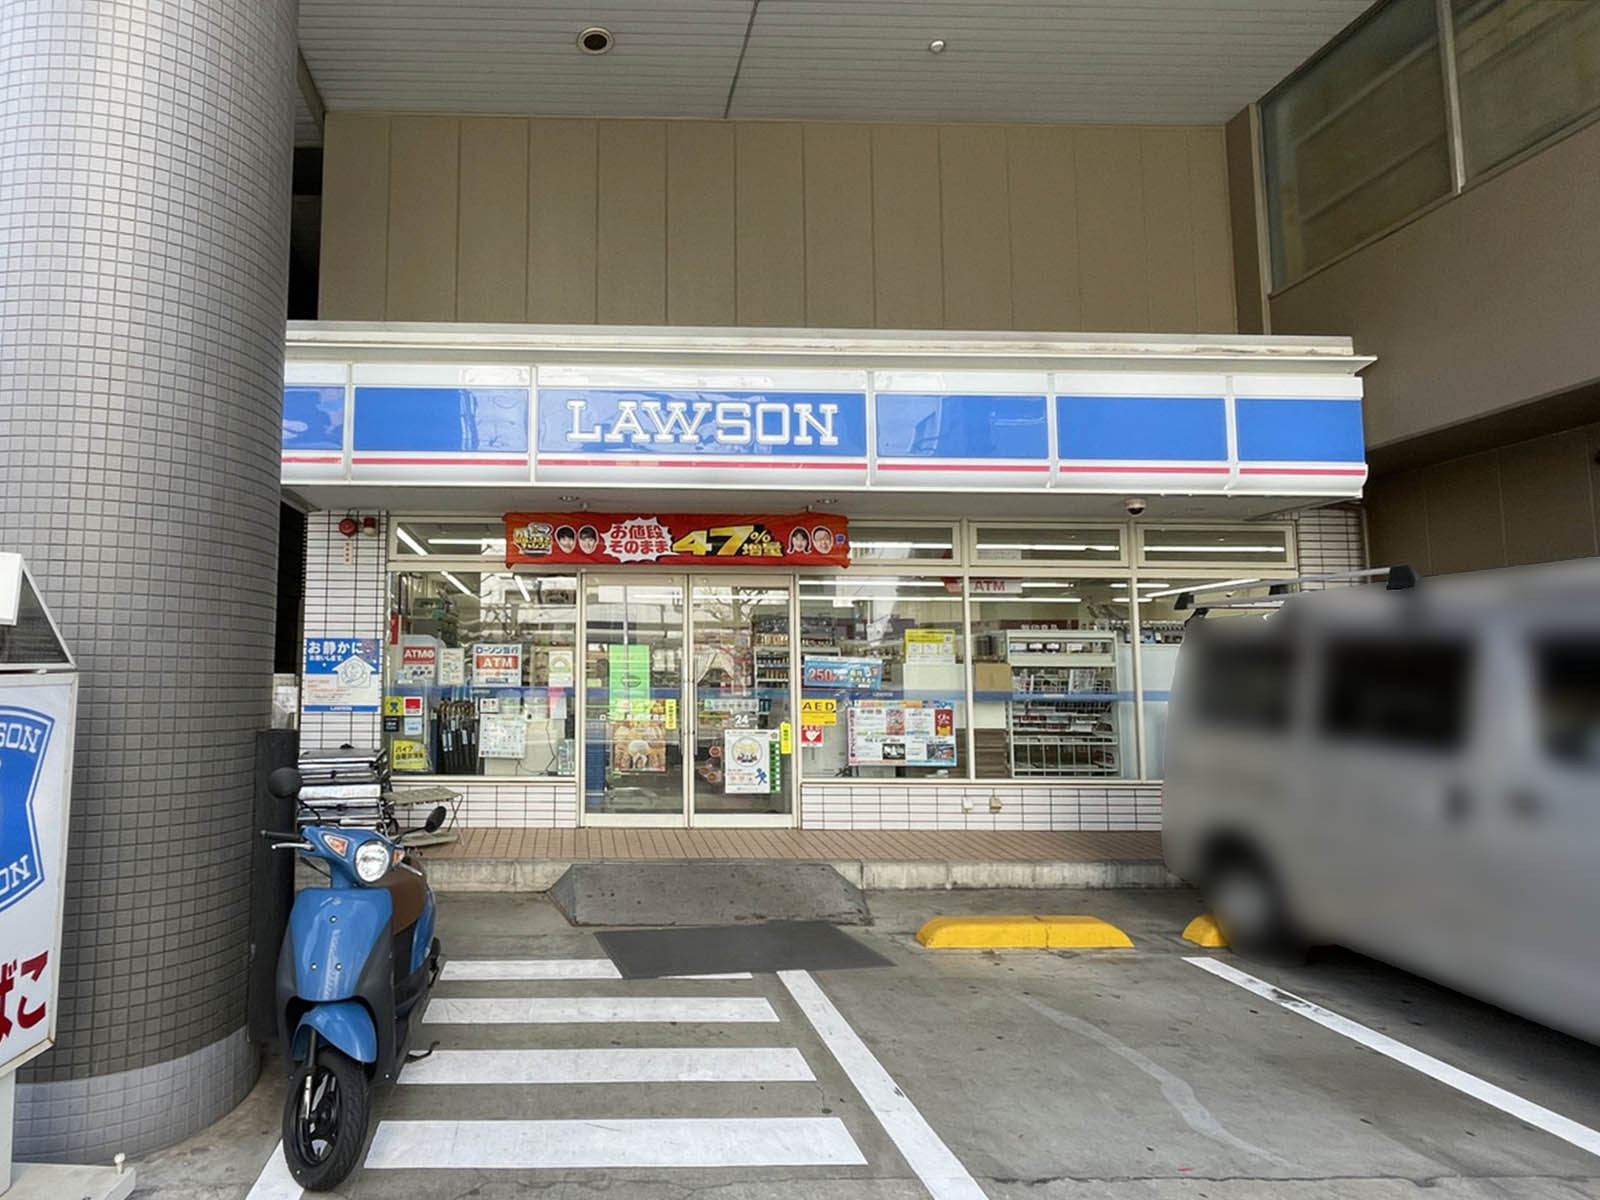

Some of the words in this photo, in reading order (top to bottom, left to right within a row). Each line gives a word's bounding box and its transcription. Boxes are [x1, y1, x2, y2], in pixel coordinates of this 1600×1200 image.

[566, 400, 839, 445] LAWSON
[610, 525, 665, 540] お値段
[610, 540, 669, 554] そのまま
[974, 581, 1006, 591] ATM
[307, 641, 363, 655] お静かに
[483, 657, 513, 668] ATM
[802, 702, 834, 711] AED
[735, 714, 749, 725] 24
